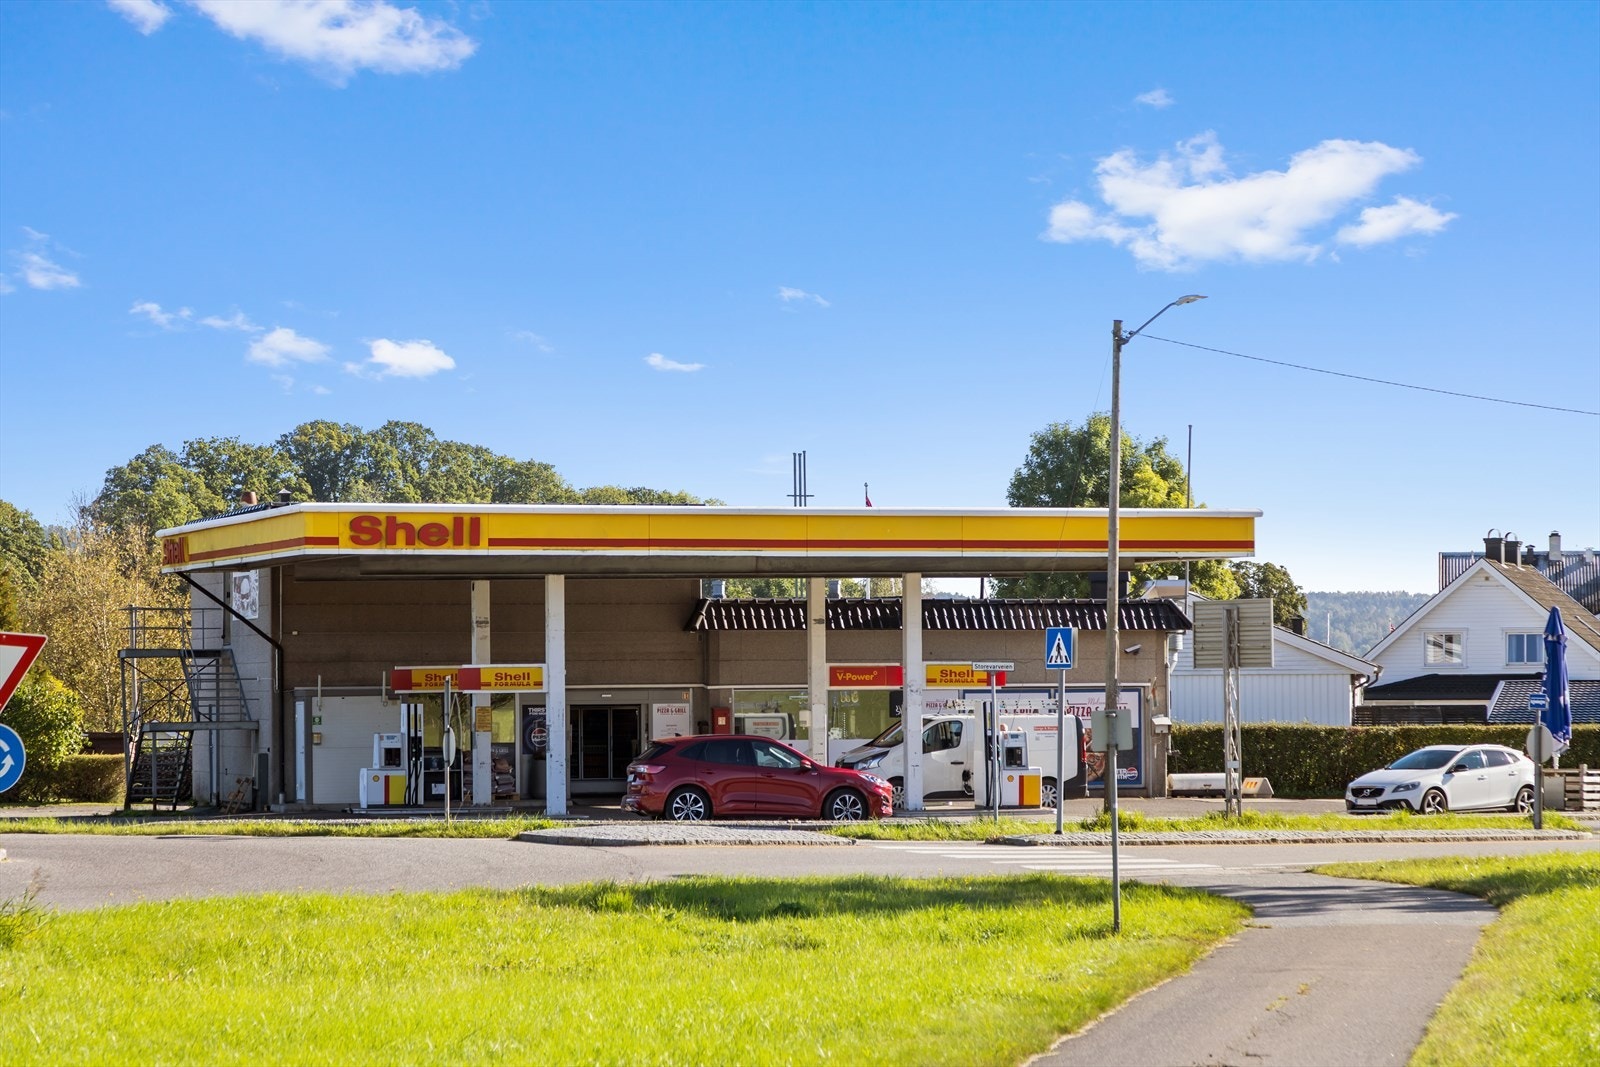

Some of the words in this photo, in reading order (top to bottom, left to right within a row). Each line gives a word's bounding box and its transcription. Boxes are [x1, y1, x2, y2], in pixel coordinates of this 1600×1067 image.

[349, 515, 481, 547] Shell
[494, 672, 531, 681] Shell
[836, 672, 875, 681] V-Power
[940, 669, 974, 678] Shell
